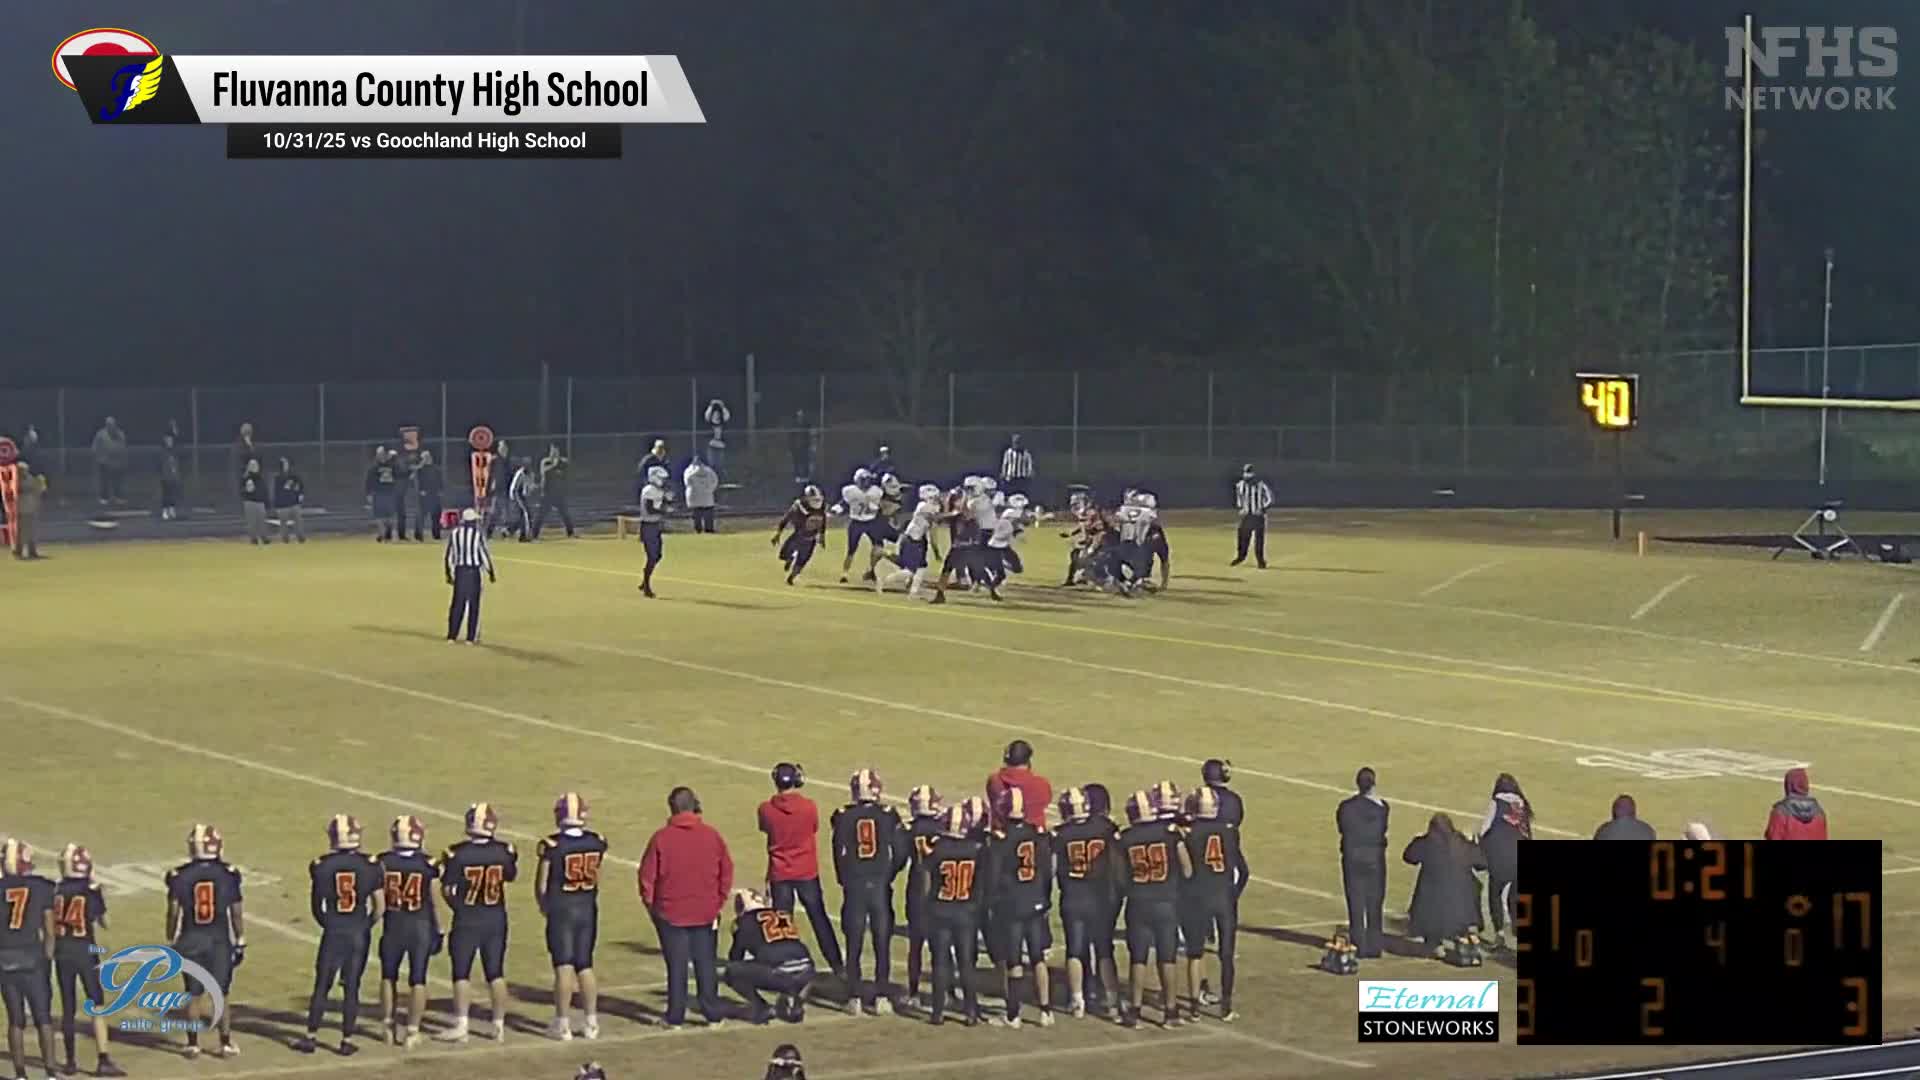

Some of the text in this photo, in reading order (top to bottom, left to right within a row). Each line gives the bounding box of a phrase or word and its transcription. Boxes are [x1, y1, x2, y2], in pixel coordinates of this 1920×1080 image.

[1582, 381, 1629, 425] 40
[856, 819, 876, 858] 9
[1205, 835, 1224, 872] 4
[563, 852, 600, 890] 55
[1017, 842, 1035, 881] 3
[6, 887, 29, 929] 7
[336, 872, 356, 912] 5
